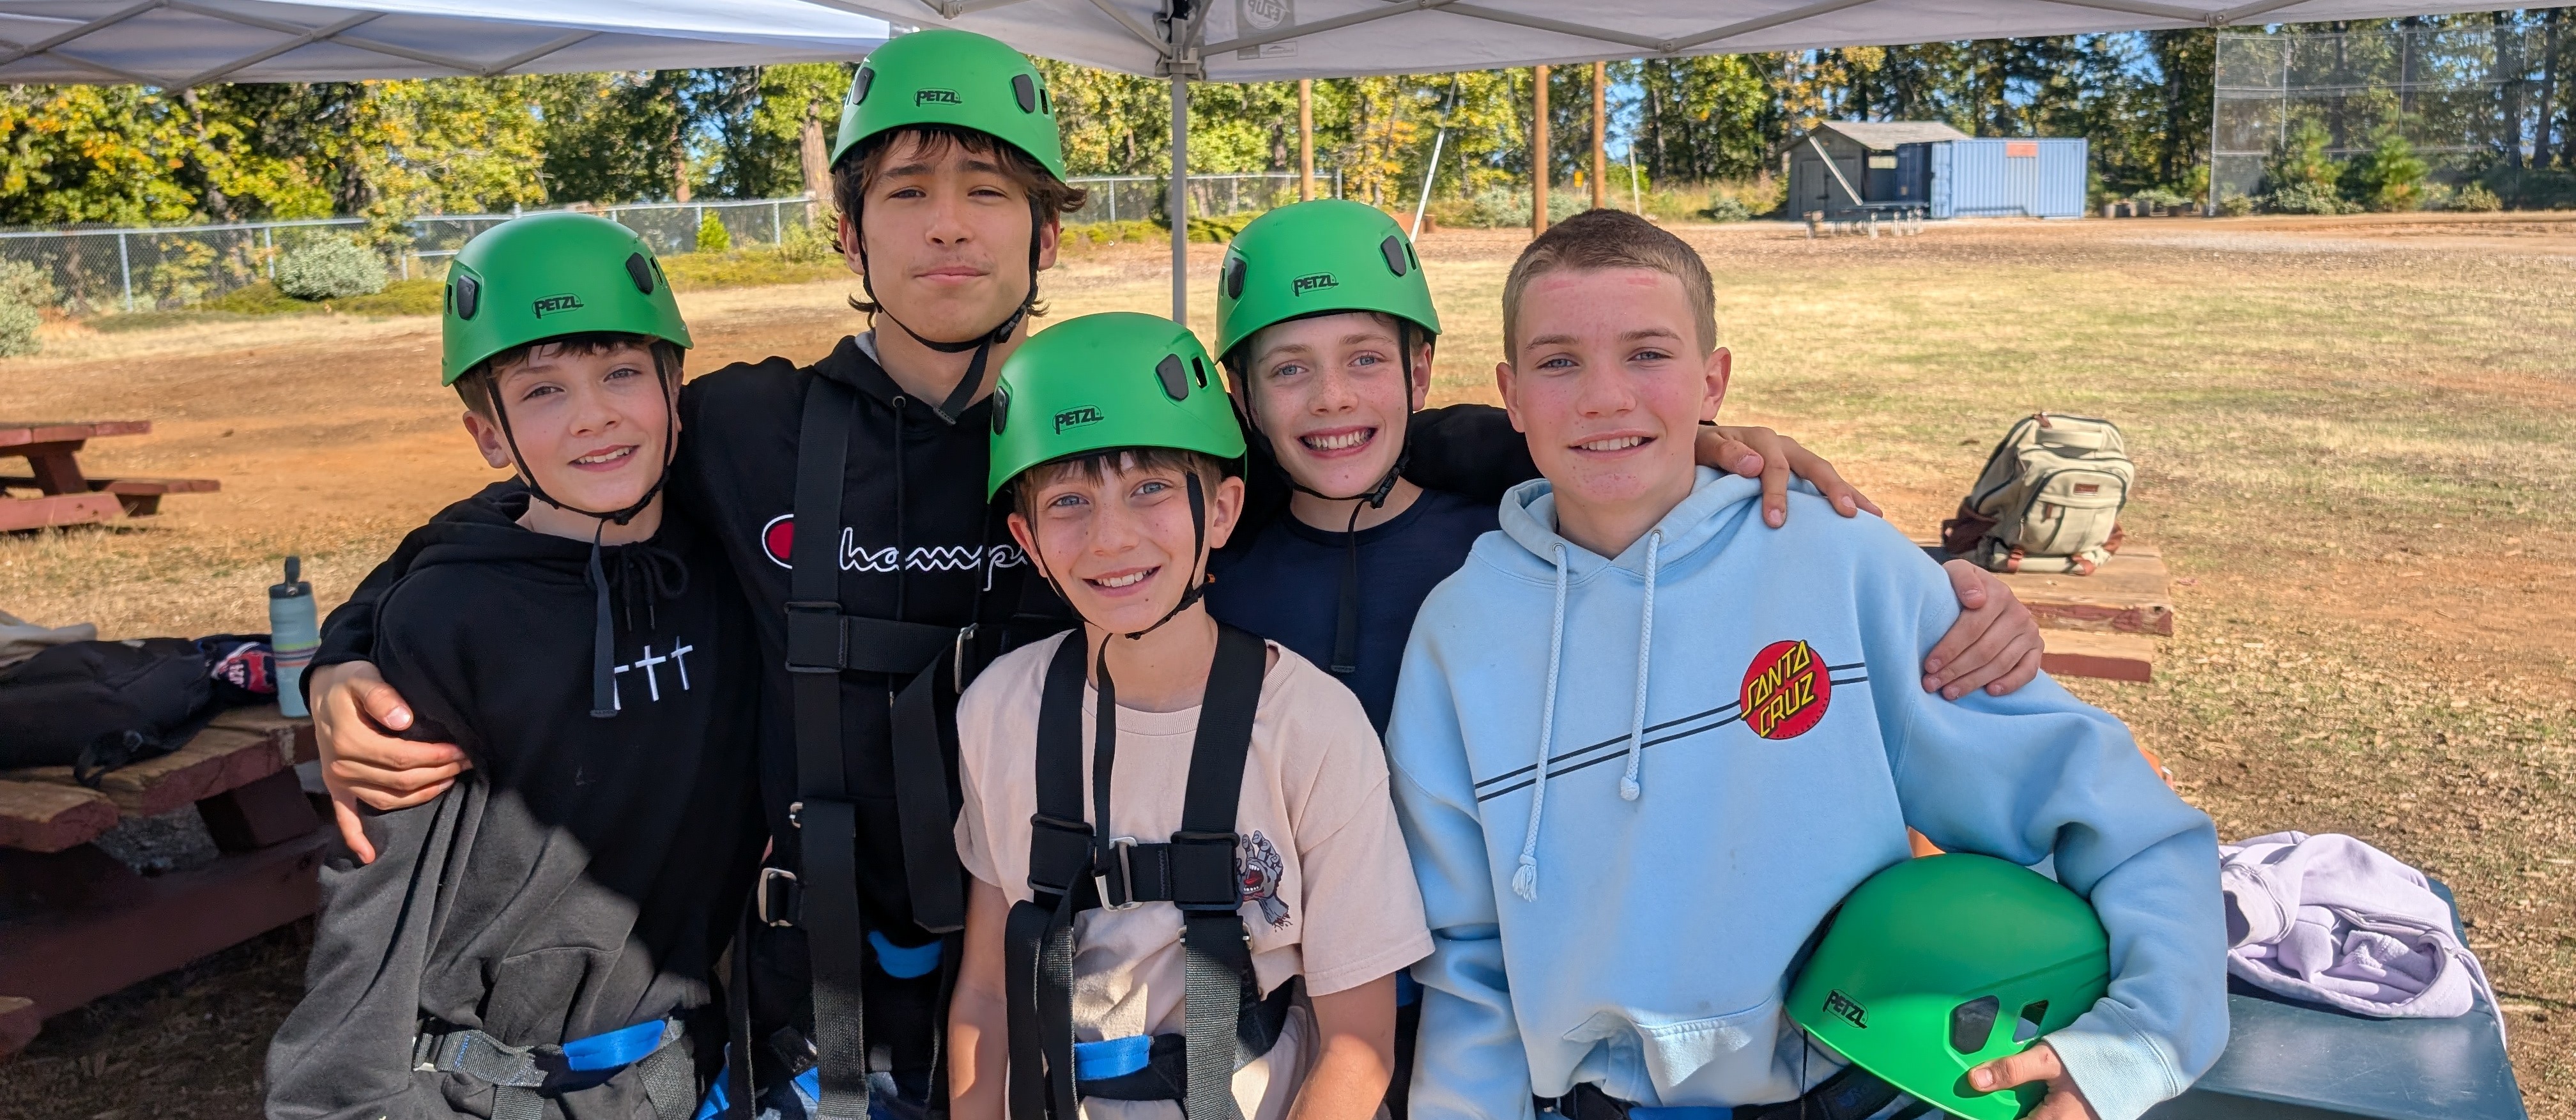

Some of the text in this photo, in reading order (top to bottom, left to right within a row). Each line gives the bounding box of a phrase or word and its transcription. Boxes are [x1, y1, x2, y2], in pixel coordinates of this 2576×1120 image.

[916, 91, 963, 107] PETZL
[1293, 275, 1339, 297] PETZL
[534, 296, 585, 319] PETZL
[1055, 408, 1105, 435] PETZL
[762, 514, 1028, 592] Champ
[1740, 640, 1812, 720] SANTA
[1759, 671, 1816, 738] CRUZ
[1822, 990, 1867, 1029] PETZL
